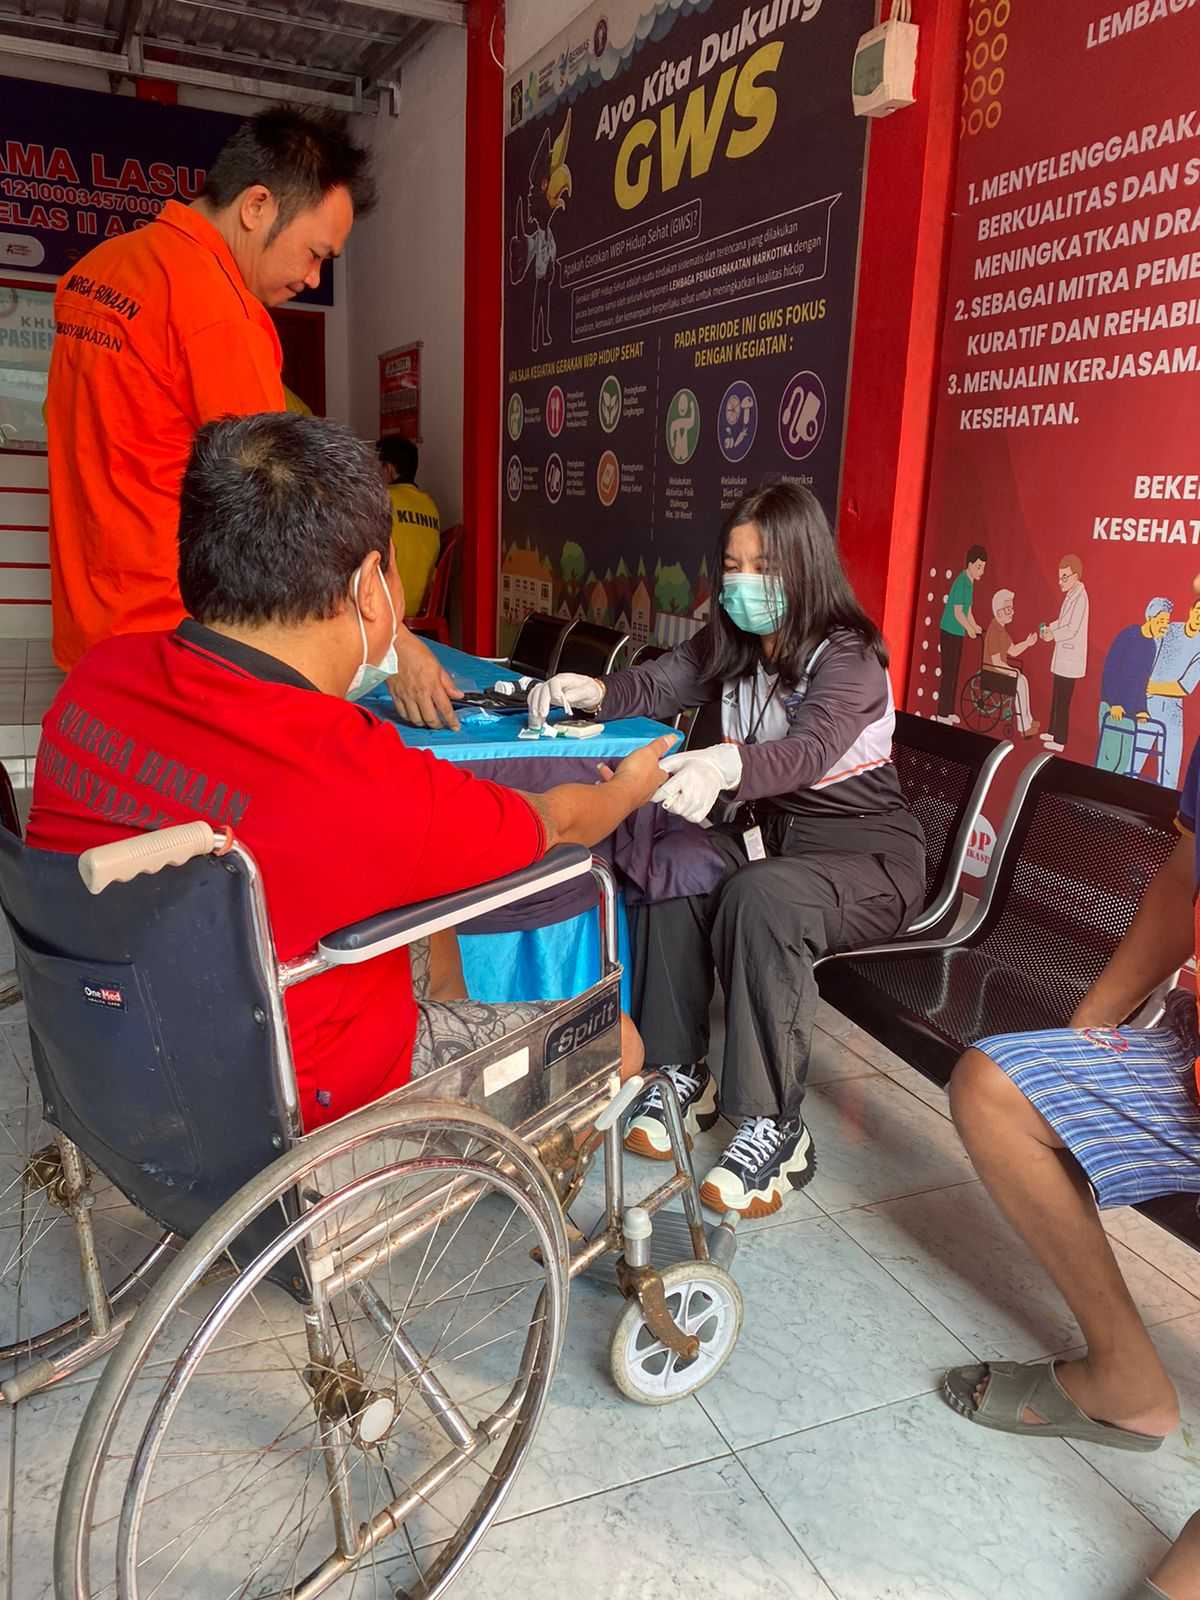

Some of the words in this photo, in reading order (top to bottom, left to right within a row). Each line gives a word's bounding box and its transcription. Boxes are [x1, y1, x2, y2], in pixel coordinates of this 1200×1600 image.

[595, 94, 636, 141] Ayo
[641, 55, 692, 112] Kita
[698, 0, 823, 77] Dukung
[614, 41, 784, 210] GWS
[0, 140, 80, 184] MA
[977, 181, 1118, 241] BERKUALITAS
[1121, 163, 1180, 203] DAN
[647, 224, 669, 244] Sehat
[670, 210, 698, 237] (GWS)?
[751, 241, 793, 266] NARKOTIKA
[793, 232, 822, 257] dengan
[974, 216, 1151, 280] MENINGKATKAN
[971, 282, 1054, 319] SEBAGAI
[1057, 267, 1130, 303] MITRA
[674, 327, 697, 349] PADA
[698, 318, 740, 343] PERIODE
[742, 315, 756, 335] INI
[758, 309, 783, 331] GWS
[785, 298, 827, 326] FOKUS
[967, 323, 1048, 356] KURATIF
[1051, 314, 1101, 345] DAN
[598, 347, 621, 365] HIDUP
[621, 341, 644, 361] SEHAT
[694, 343, 733, 368] DENGAN
[734, 334, 788, 361] KEGIATAN
[963, 362, 1060, 393] MENJALIN
[959, 401, 1080, 430] KESEHATAN.
[397, 509, 440, 529] KLINIK
[135, 749, 253, 827] BINAAN
[557, 1000, 616, 1053] Spirit
